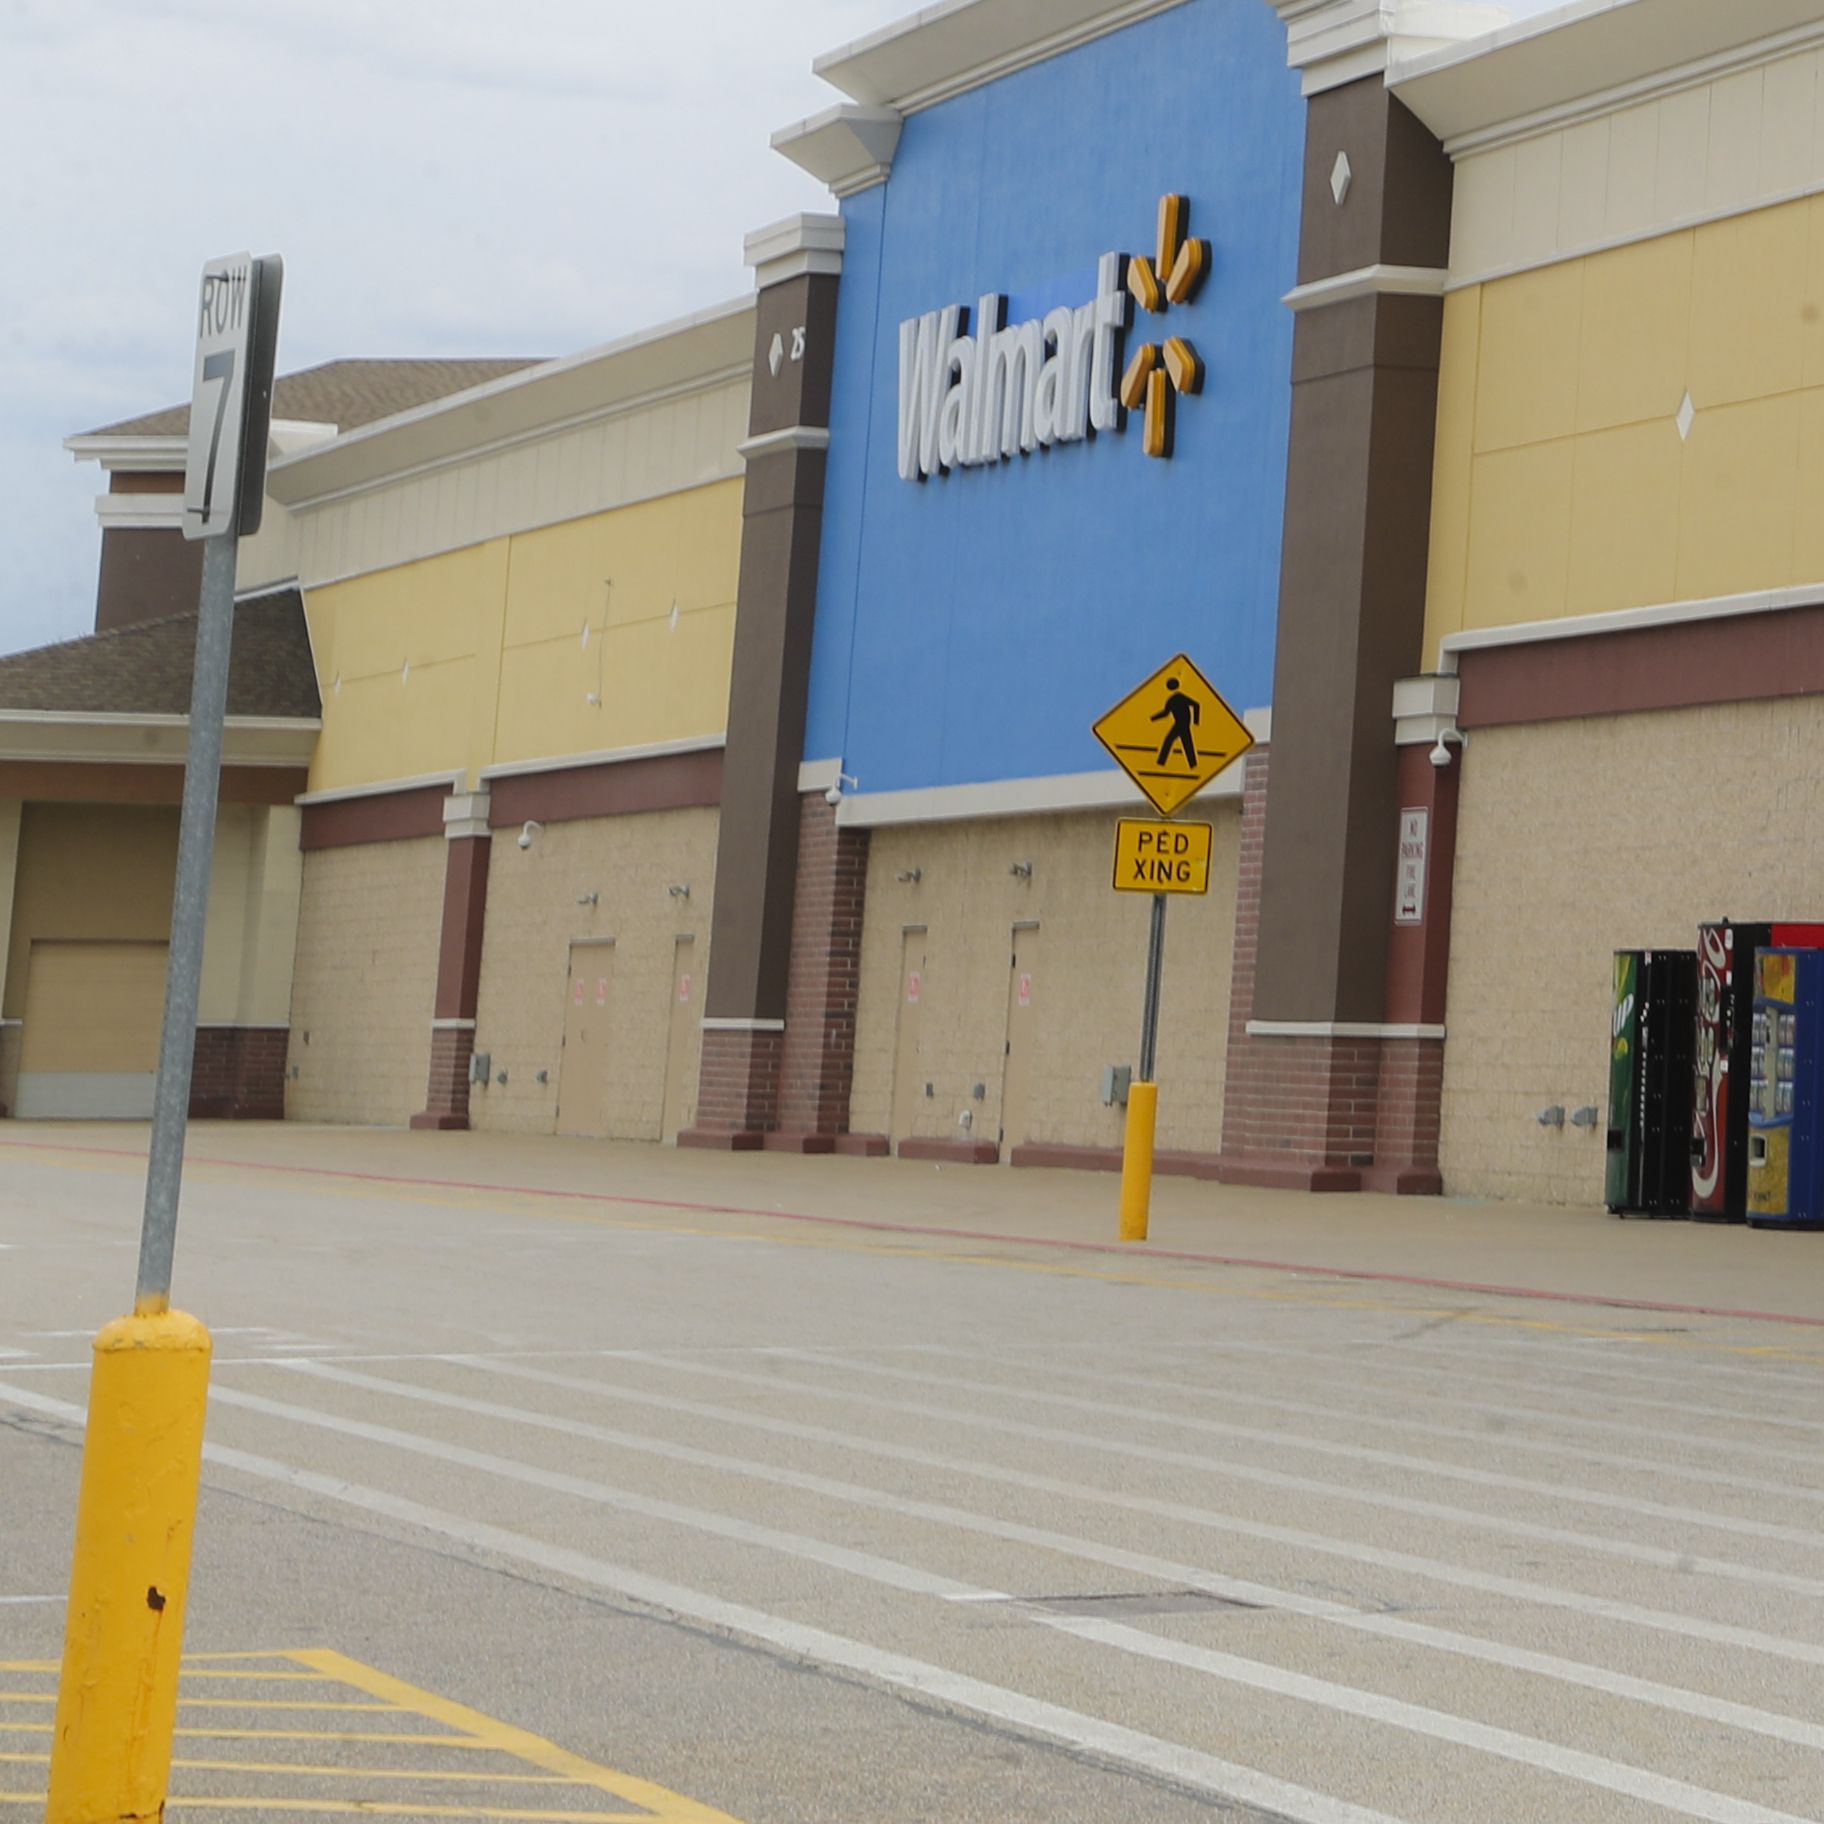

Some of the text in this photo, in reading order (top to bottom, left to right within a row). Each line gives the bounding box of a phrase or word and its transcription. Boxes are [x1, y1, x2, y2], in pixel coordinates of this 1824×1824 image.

[200, 265, 248, 338] ROW
[898, 252, 1126, 480] Walmart
[202, 348, 235, 524] 7
[1133, 858, 1191, 883] XING
[1137, 830, 1189, 854] PED
